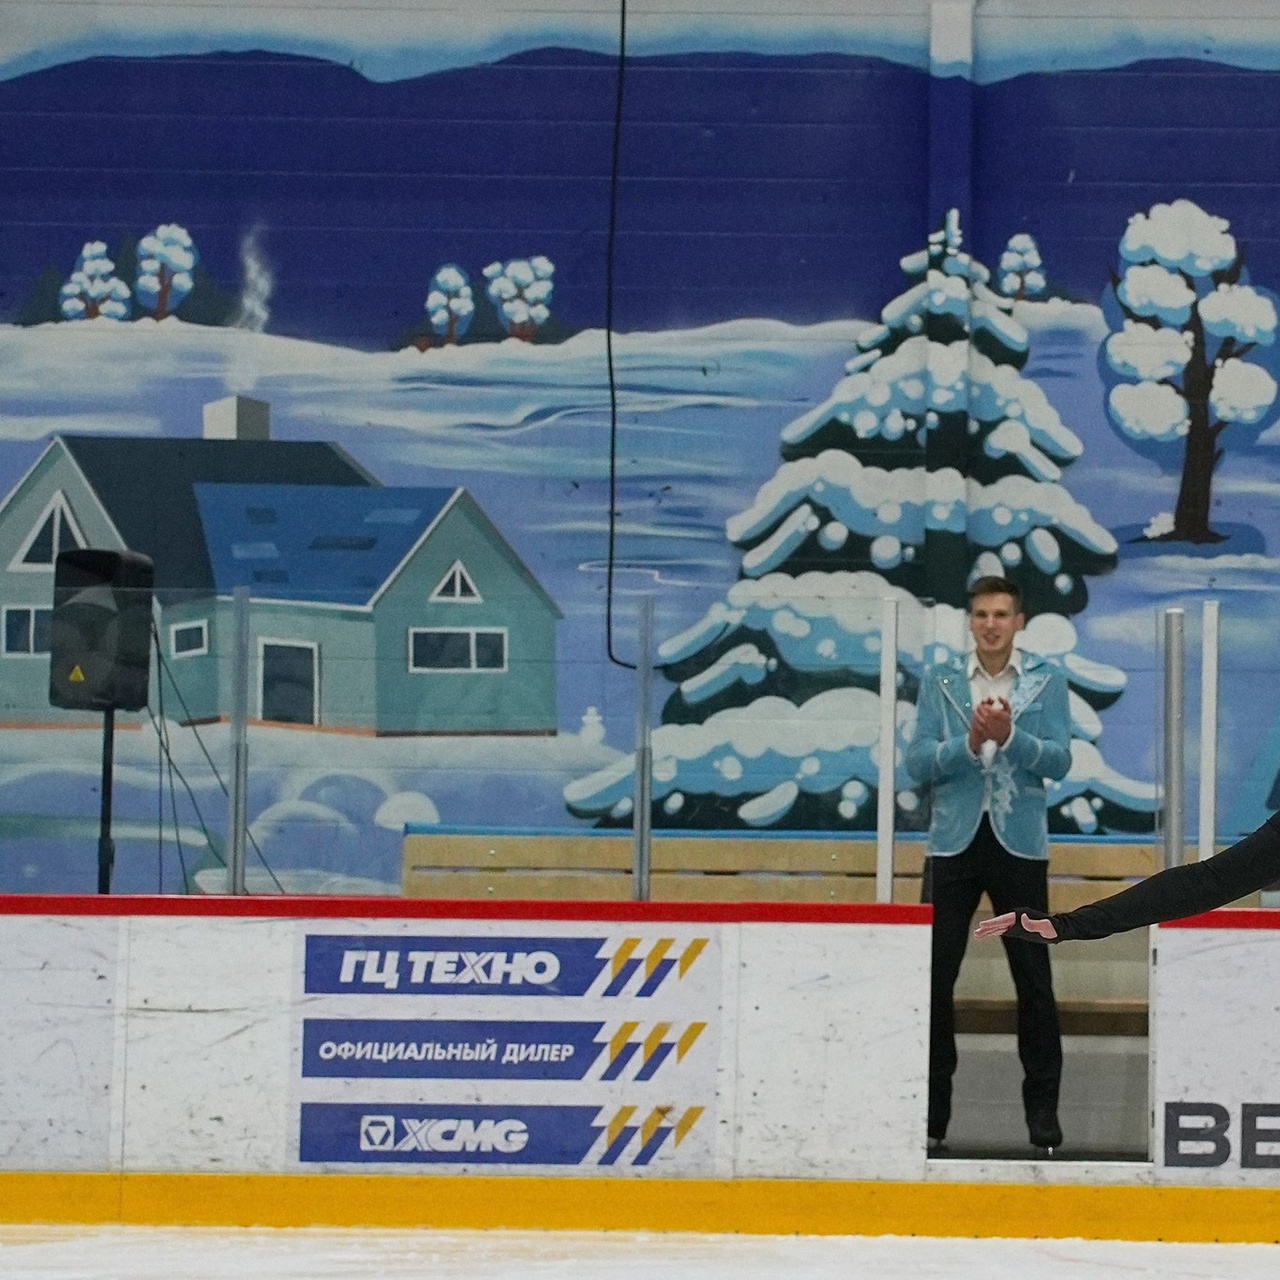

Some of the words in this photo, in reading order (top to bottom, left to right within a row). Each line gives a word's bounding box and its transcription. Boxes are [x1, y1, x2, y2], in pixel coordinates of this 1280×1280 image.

[339, 950, 400, 989] ГЦ
[408, 951, 561, 985] ТЕХНО
[318, 1037, 498, 1063] ОФИЦИАЛЬНЫЙ
[501, 1043, 575, 1065] ДИЛЕР
[393, 1118, 530, 1154] XCMG
